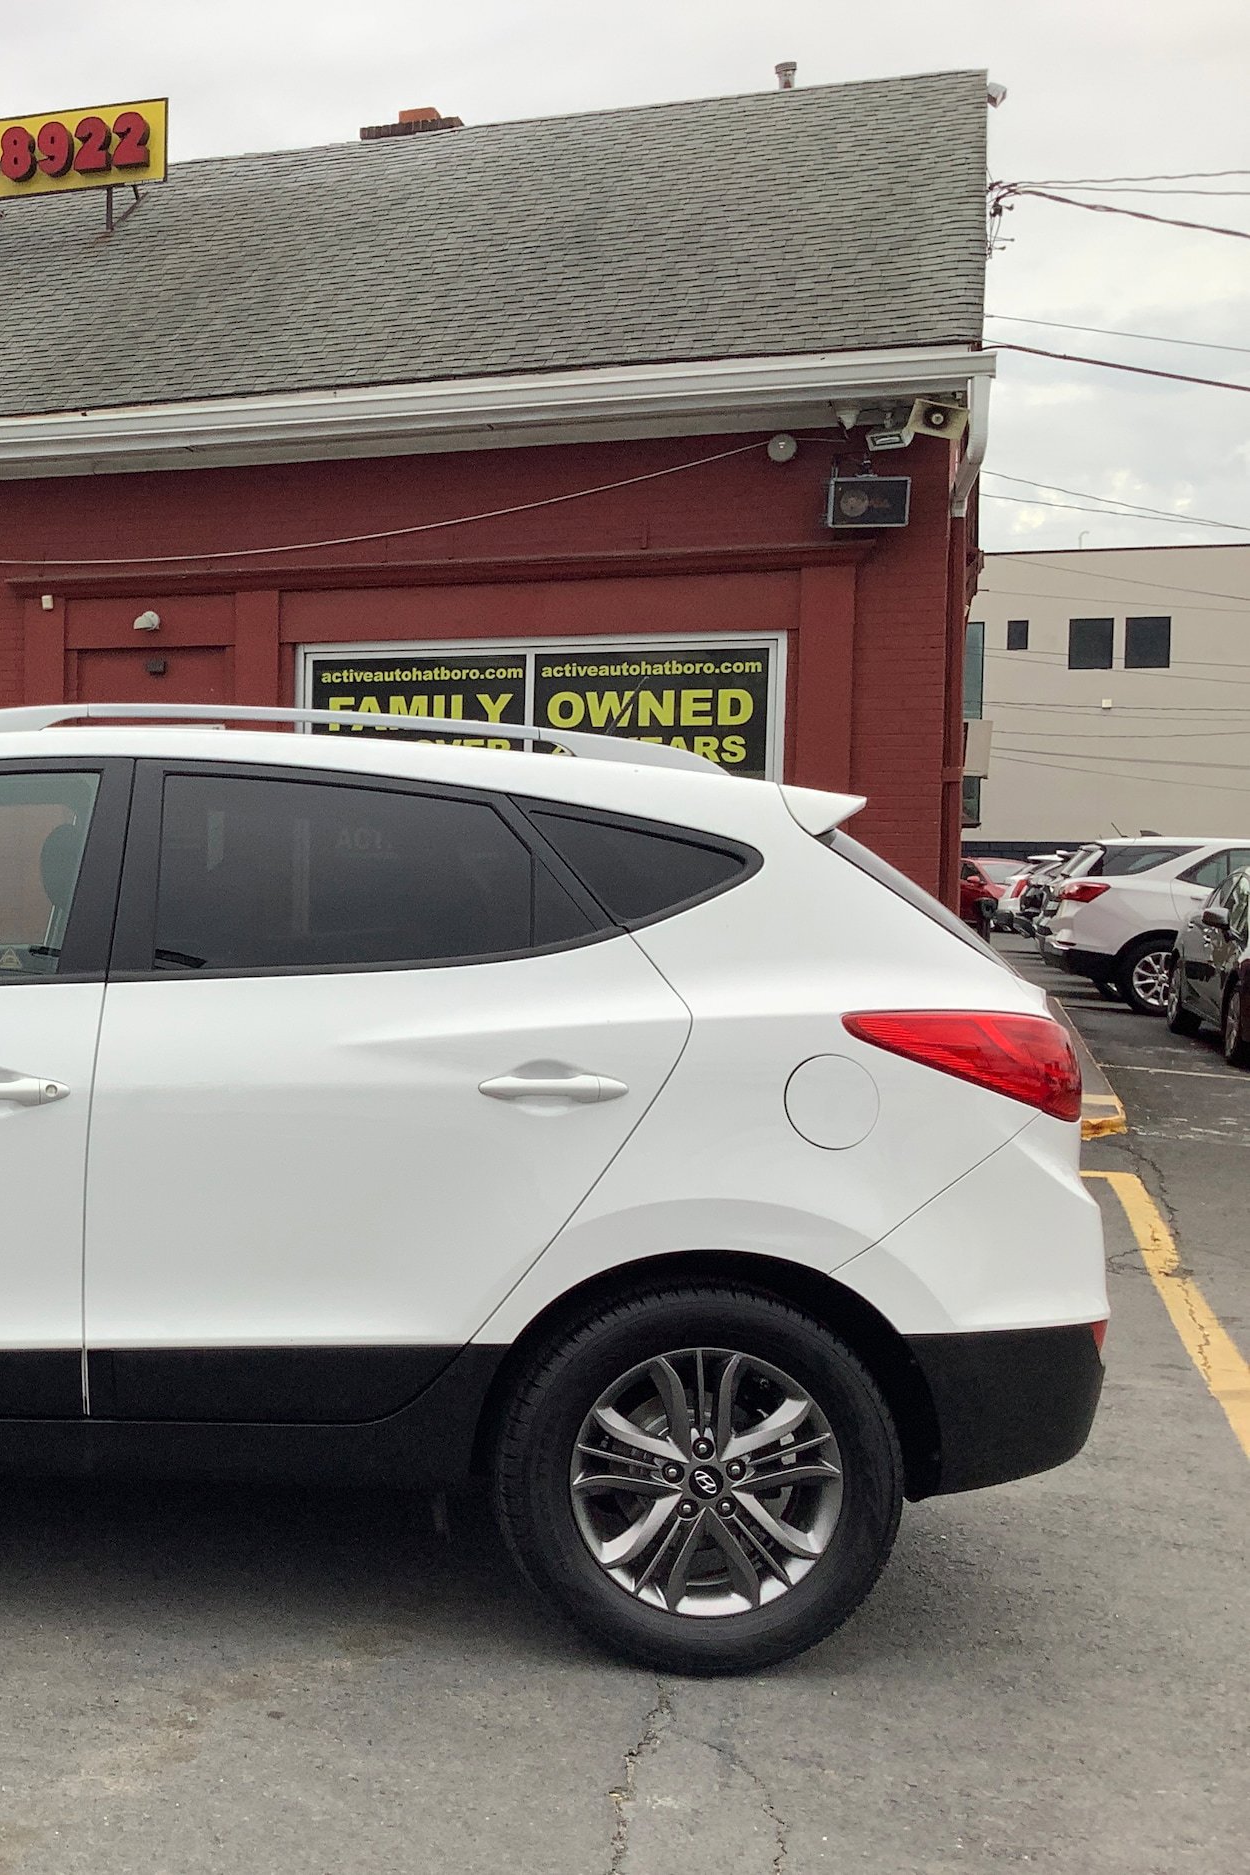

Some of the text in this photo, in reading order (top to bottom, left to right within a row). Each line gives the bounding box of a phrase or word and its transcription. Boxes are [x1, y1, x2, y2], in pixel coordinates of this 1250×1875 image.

[321, 667, 524, 683] activeautohatboro.com
[541, 660, 762, 678] activeautohatboro.com
[546, 688, 754, 729] OWNED
